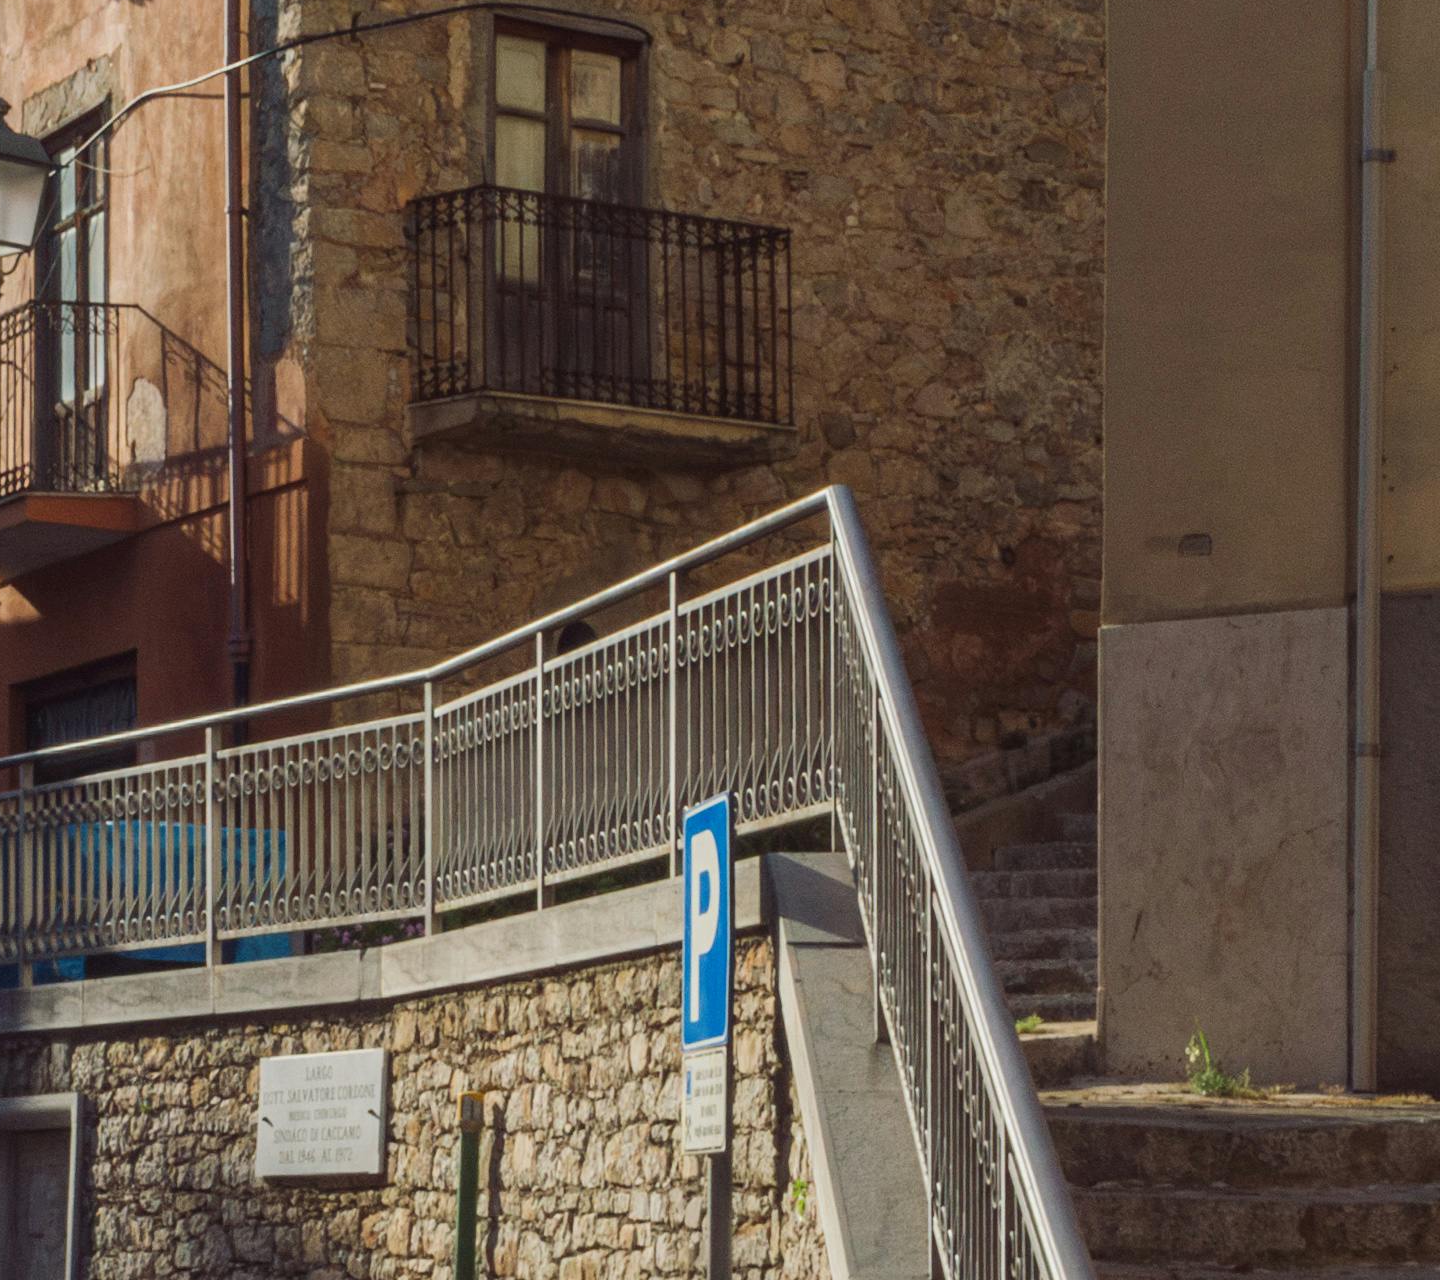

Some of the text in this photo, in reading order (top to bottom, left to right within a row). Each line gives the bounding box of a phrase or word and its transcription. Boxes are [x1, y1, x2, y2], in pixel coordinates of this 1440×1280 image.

[690, 828, 720, 1023] P
[305, 1065, 334, 1081] LARGO
[287, 1086, 335, 1103] SALVATORE
[273, 1127, 307, 1144] SINDACO
[310, 1127, 319, 1141] DI
[278, 1150, 295, 1164] DAL
[321, 1148, 333, 1163] AL
